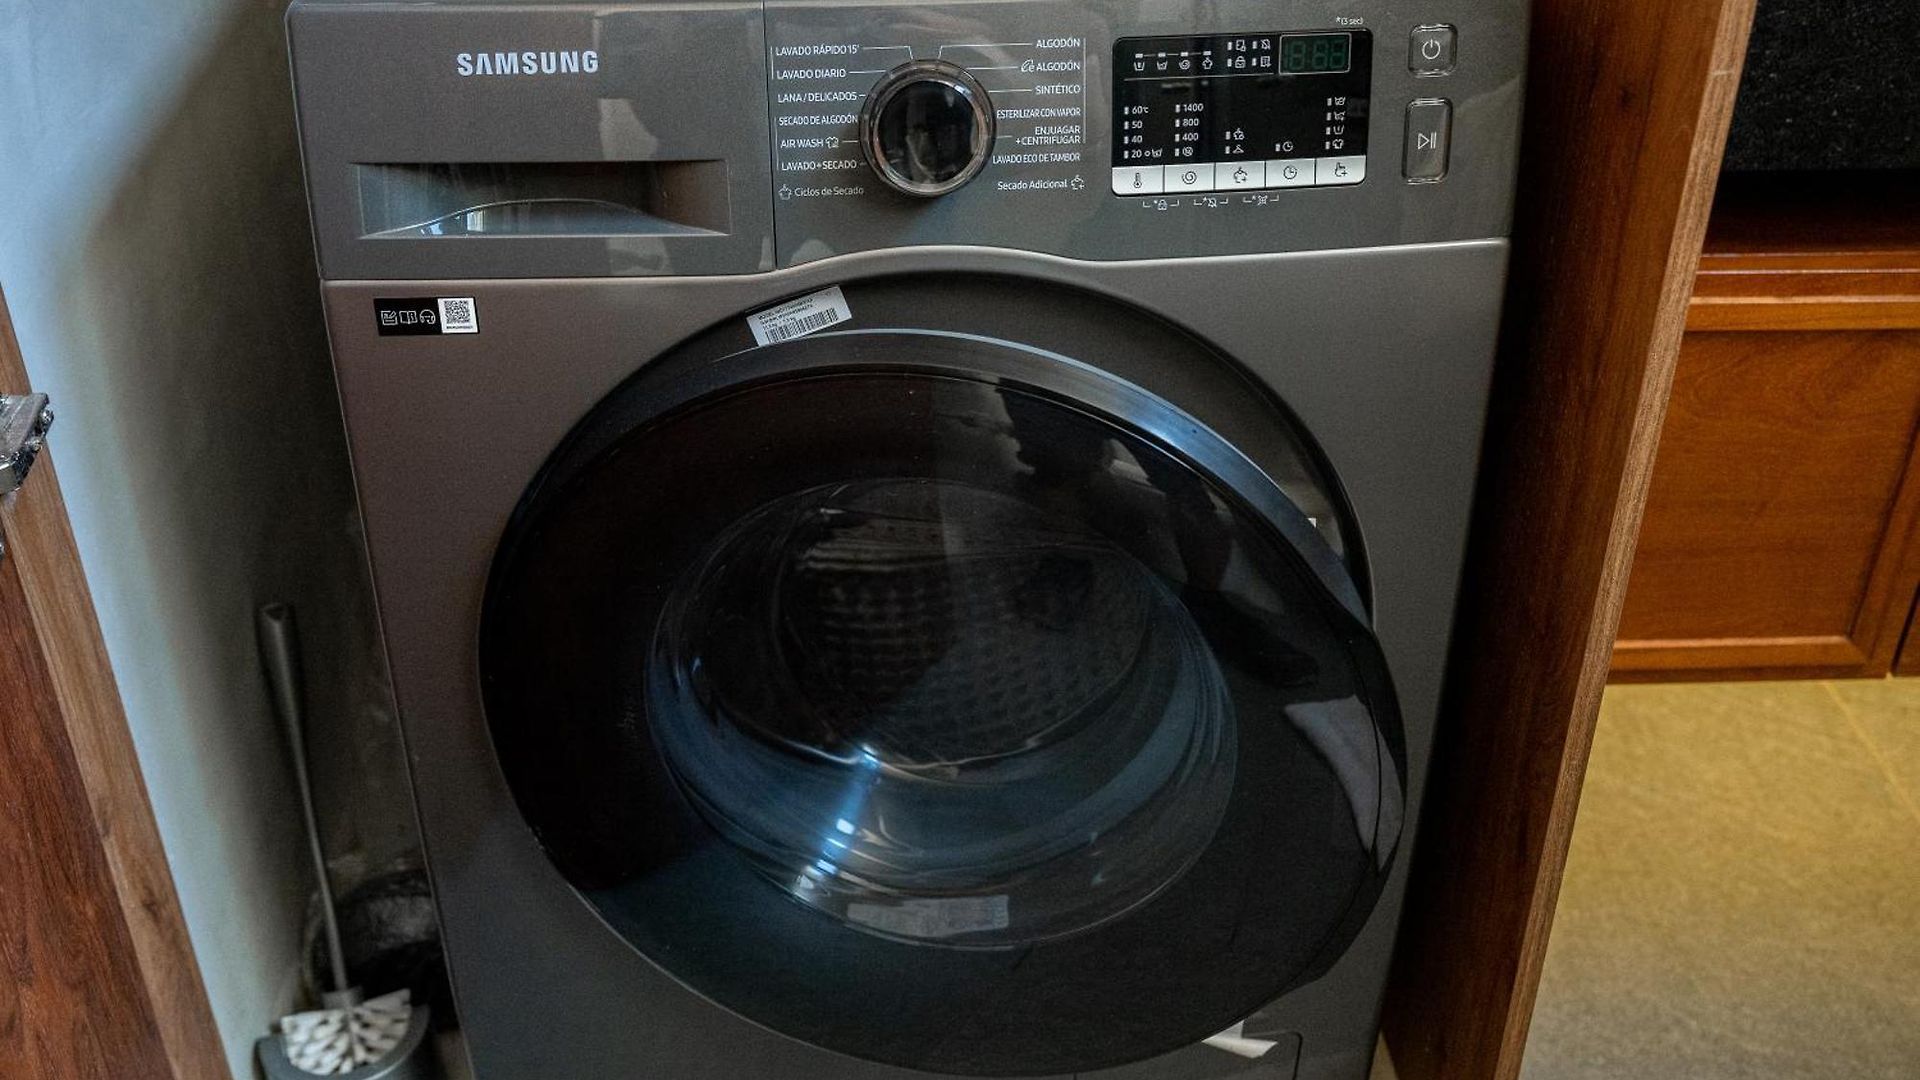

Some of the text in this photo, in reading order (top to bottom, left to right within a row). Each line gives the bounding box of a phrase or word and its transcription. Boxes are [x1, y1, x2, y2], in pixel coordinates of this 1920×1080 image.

[1036, 36, 1080, 48] ALGODÓN
[776, 45, 811, 56] LAVADO
[813, 43, 847, 55] RÁPIDO
[457, 51, 599, 76] SAMSUNG
[1036, 59, 1080, 71] ALGODÓN
[777, 68, 847, 80] LAVADO DIARIO
[1035, 82, 1080, 95] SINTÉTICO
[997, 107, 1080, 119] ESTERILIZAR CON VAPOR
[1182, 103, 1204, 112] 1400
[779, 114, 858, 126] SECADO DE ALGODÓN
[1132, 120, 1143, 129] 50
[1182, 118, 1199, 127] 800
[1035, 125, 1080, 135] ENJUAGAR
[1131, 135, 1143, 143] 40
[1182, 132, 1199, 141] 400
[780, 138, 824, 148] AIR WASH
[993, 152, 1080, 164] LAVADO ECO DE TAMBOR
[1131, 149, 1142, 158] 20
[998, 179, 1068, 190] Secado Adicional
[794, 185, 864, 197] Ciclos de Secado
